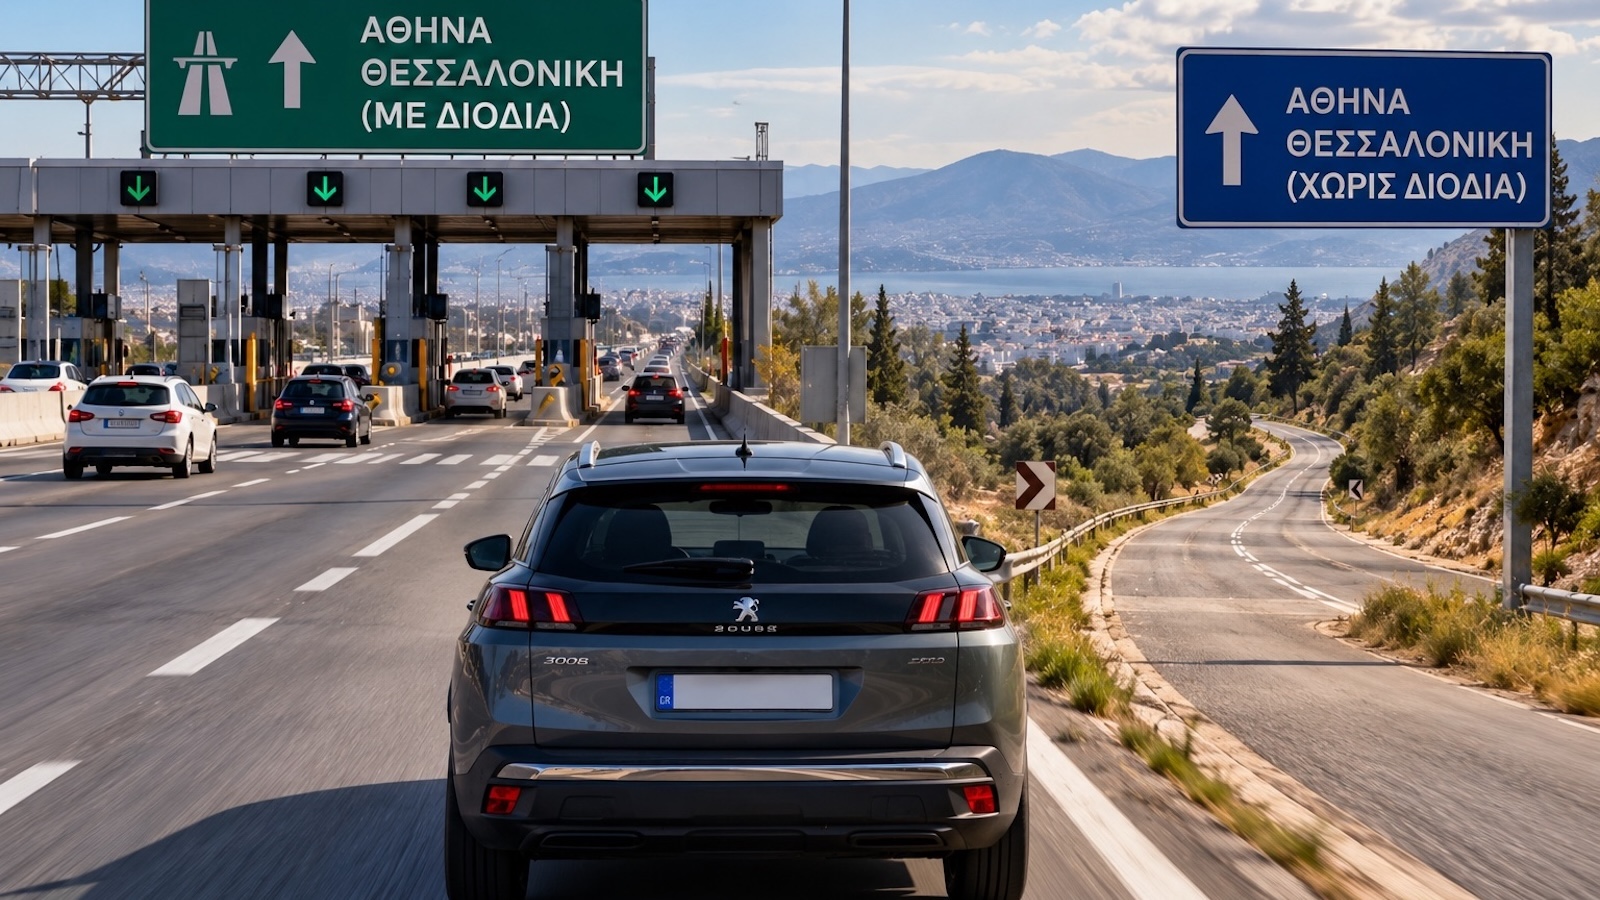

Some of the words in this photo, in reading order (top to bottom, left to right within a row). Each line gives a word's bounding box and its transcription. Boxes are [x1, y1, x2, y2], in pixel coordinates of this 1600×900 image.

[360, 16, 493, 44] ΑΘΗΝΑ
[361, 58, 624, 88] ΘΕΣΣΑΛΟΝΙΚΗ
[1286, 87, 1411, 115] ΑΘΗΝΑ
[361, 99, 427, 133] (ΜΕ
[436, 101, 572, 134] ΔΙΟΔΙΑ)
[1286, 129, 1533, 158] ΘΕΣΣΑΛΟΝΙΚΗ
[1287, 170, 1396, 204] (ΧΩΡΙΣ
[1404, 172, 1527, 204] ΔΙΟΔΙΑ)
[659, 695, 671, 705] GR
